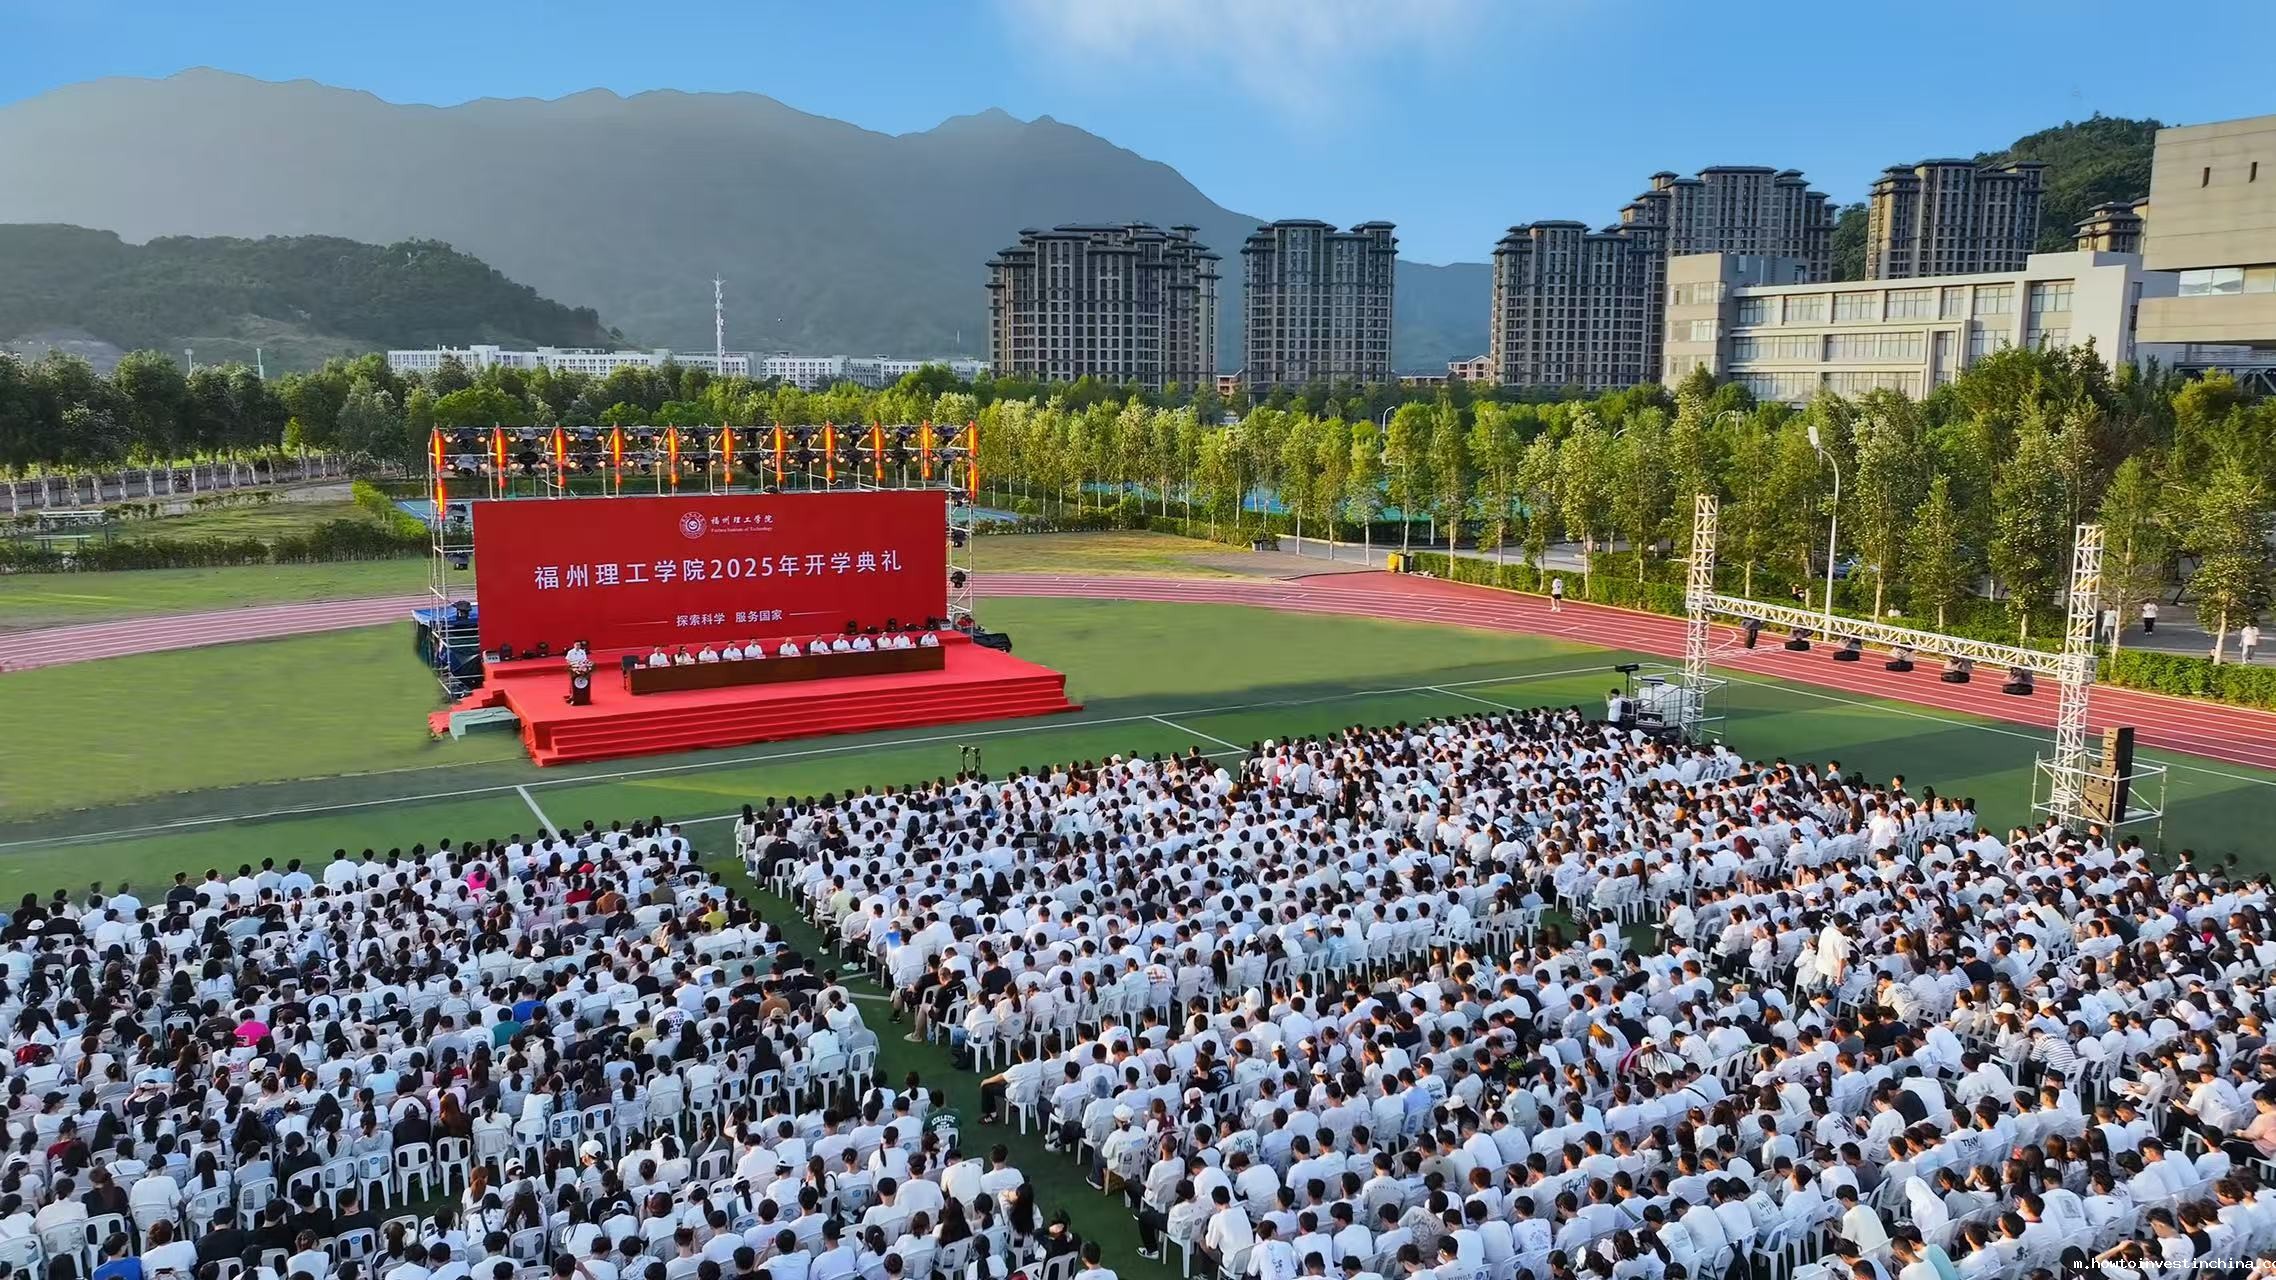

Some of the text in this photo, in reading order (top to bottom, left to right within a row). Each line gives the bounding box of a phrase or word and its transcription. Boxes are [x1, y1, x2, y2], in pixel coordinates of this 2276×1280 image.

[711, 514, 773, 525] 福州理工学院
[534, 550, 902, 590] 福州理工学院2025年开学典礼
[676, 609, 783, 627] 探索科学 服务国家
